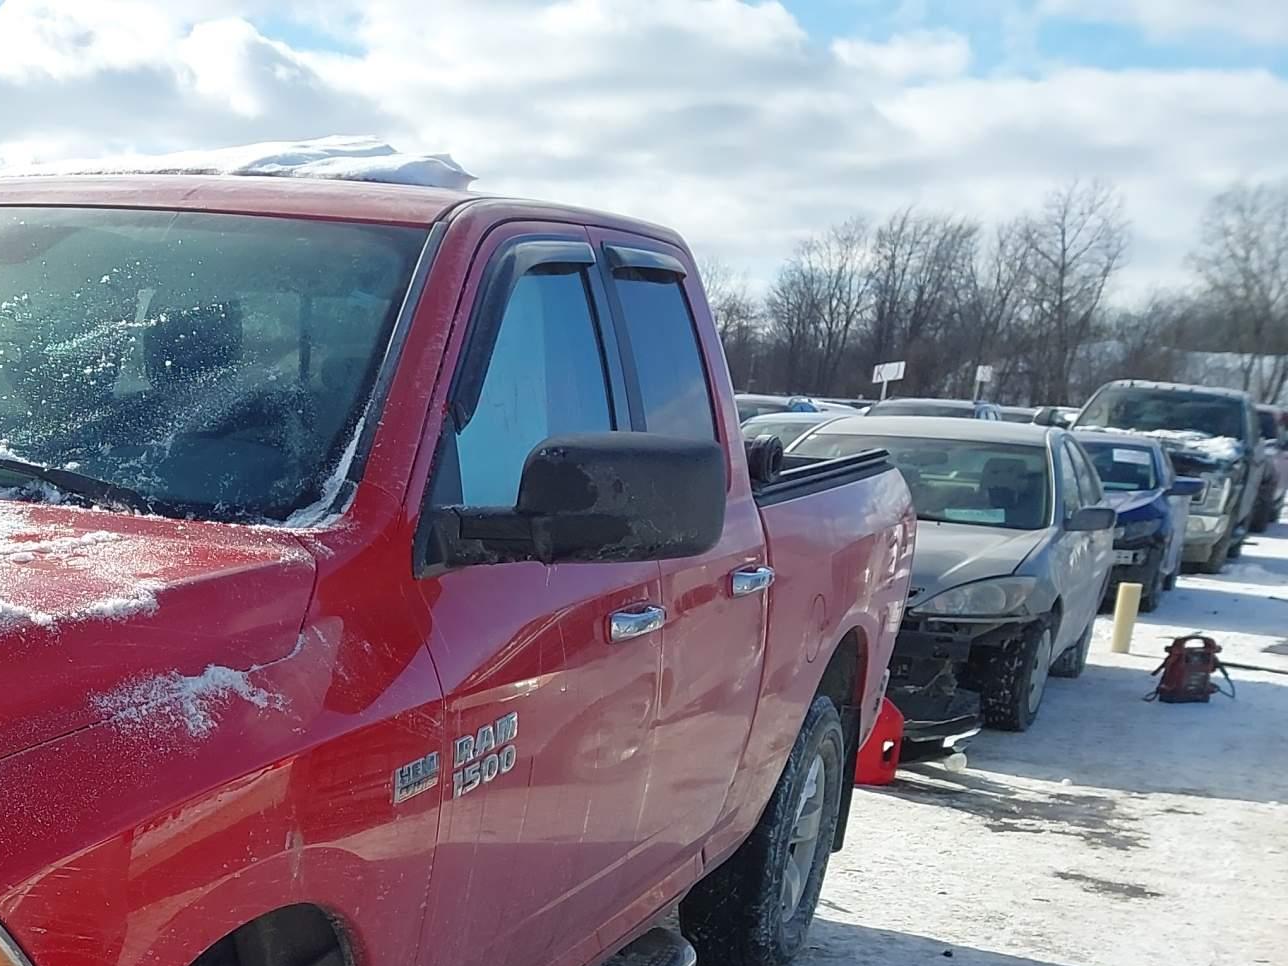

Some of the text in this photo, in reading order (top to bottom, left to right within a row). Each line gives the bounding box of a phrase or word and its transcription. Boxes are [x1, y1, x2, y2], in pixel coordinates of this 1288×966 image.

[453, 711, 518, 769] RAM
[397, 751, 440, 787] HEMI
[452, 744, 517, 800] 1500
